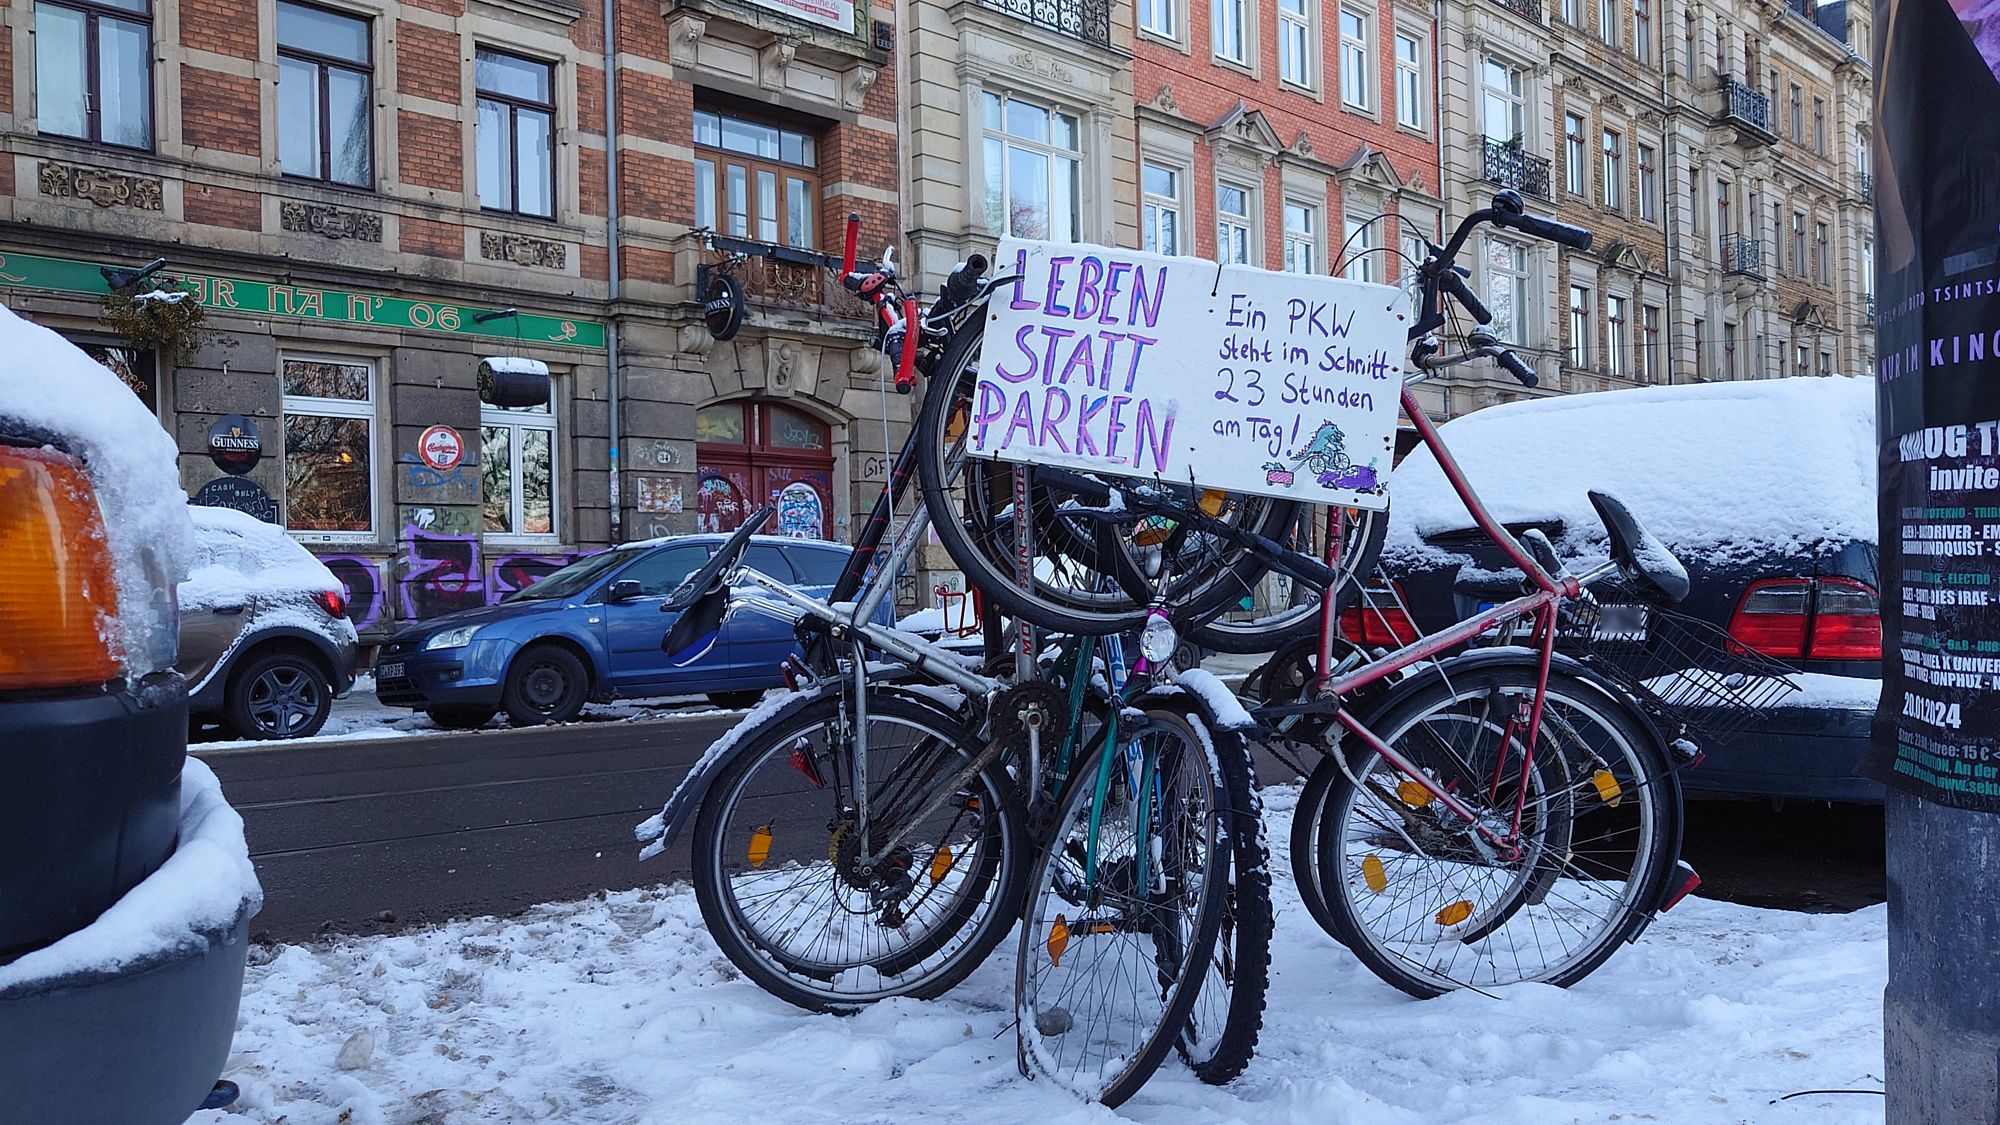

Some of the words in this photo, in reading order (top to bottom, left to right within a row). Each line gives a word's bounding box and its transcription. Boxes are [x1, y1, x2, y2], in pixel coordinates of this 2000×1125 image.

[268, 285, 323, 317] NA
[1010, 248, 1168, 328] LEBEN
[1225, 294, 1267, 332] Ein
[1287, 298, 1355, 339] PKW
[995, 324, 1158, 393] STATT
[1219, 337, 1272, 363] steht
[1282, 341, 1309, 366] im
[1318, 344, 1388, 381] Schritt
[1881, 352, 1901, 384] NUR
[1905, 343, 1919, 374] IM
[1281, 372, 1375, 412] Stunden
[212, 436, 259, 449] GUINNESS
[975, 380, 1178, 473] PARKEN
[1212, 418, 1241, 438] am
[1245, 414, 1302, 460] Tag!
[1975, 420, 2000, 456] T
[211, 483, 235, 492] CASH
[1977, 640, 2000, 652] DUB
[1902, 691, 1962, 729] 20.01.2024
[1954, 759, 1972, 776] An
[1974, 763, 1998, 779] der
[1962, 744, 1977, 760] 15
